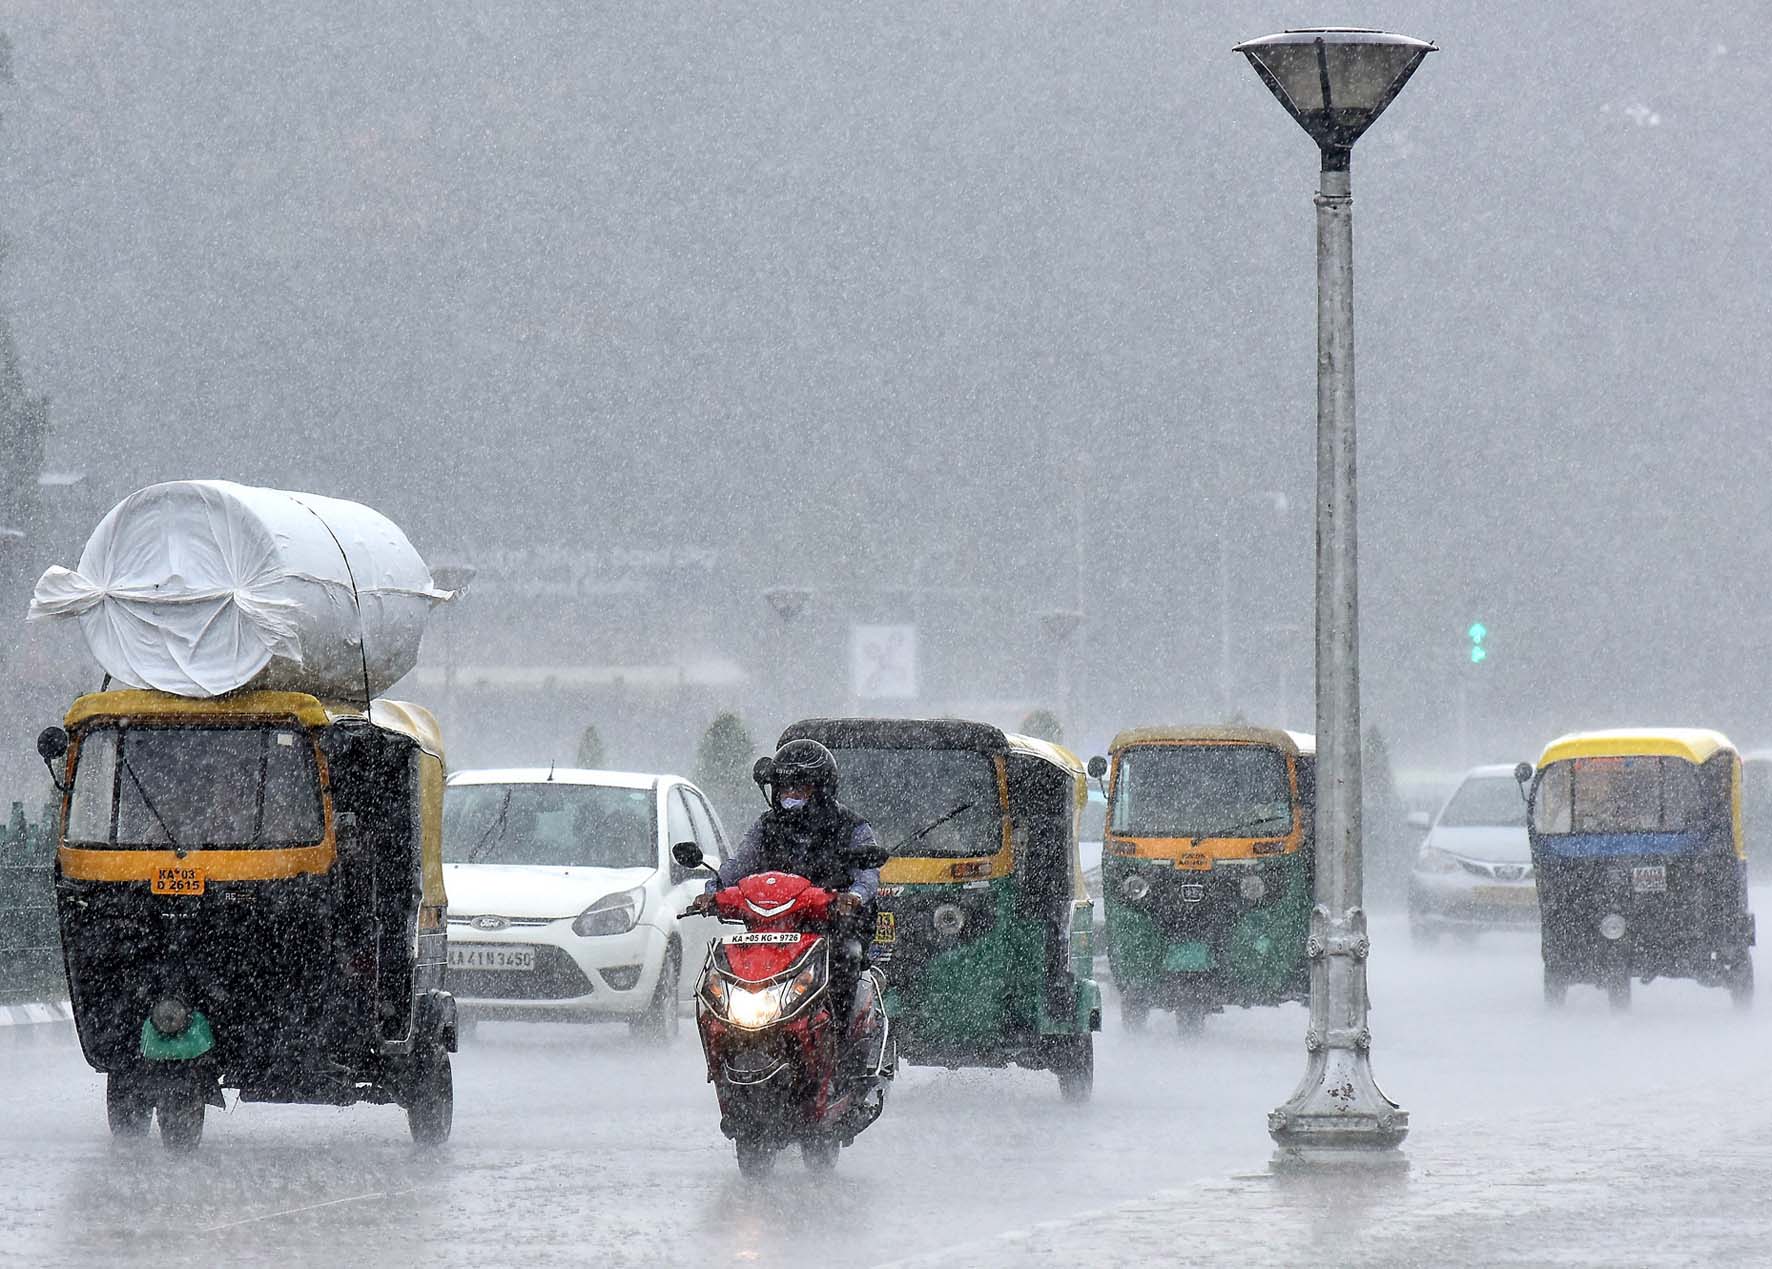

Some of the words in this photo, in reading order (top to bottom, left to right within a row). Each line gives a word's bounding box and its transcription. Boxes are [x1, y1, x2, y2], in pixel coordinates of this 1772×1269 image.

[159, 869, 174, 880] KA
[181, 869, 195, 880] 03
[169, 881, 200, 890] 2615
[732, 935, 743, 943] KA
[761, 934, 773, 942] KG
[780, 934, 798, 942] 9726
